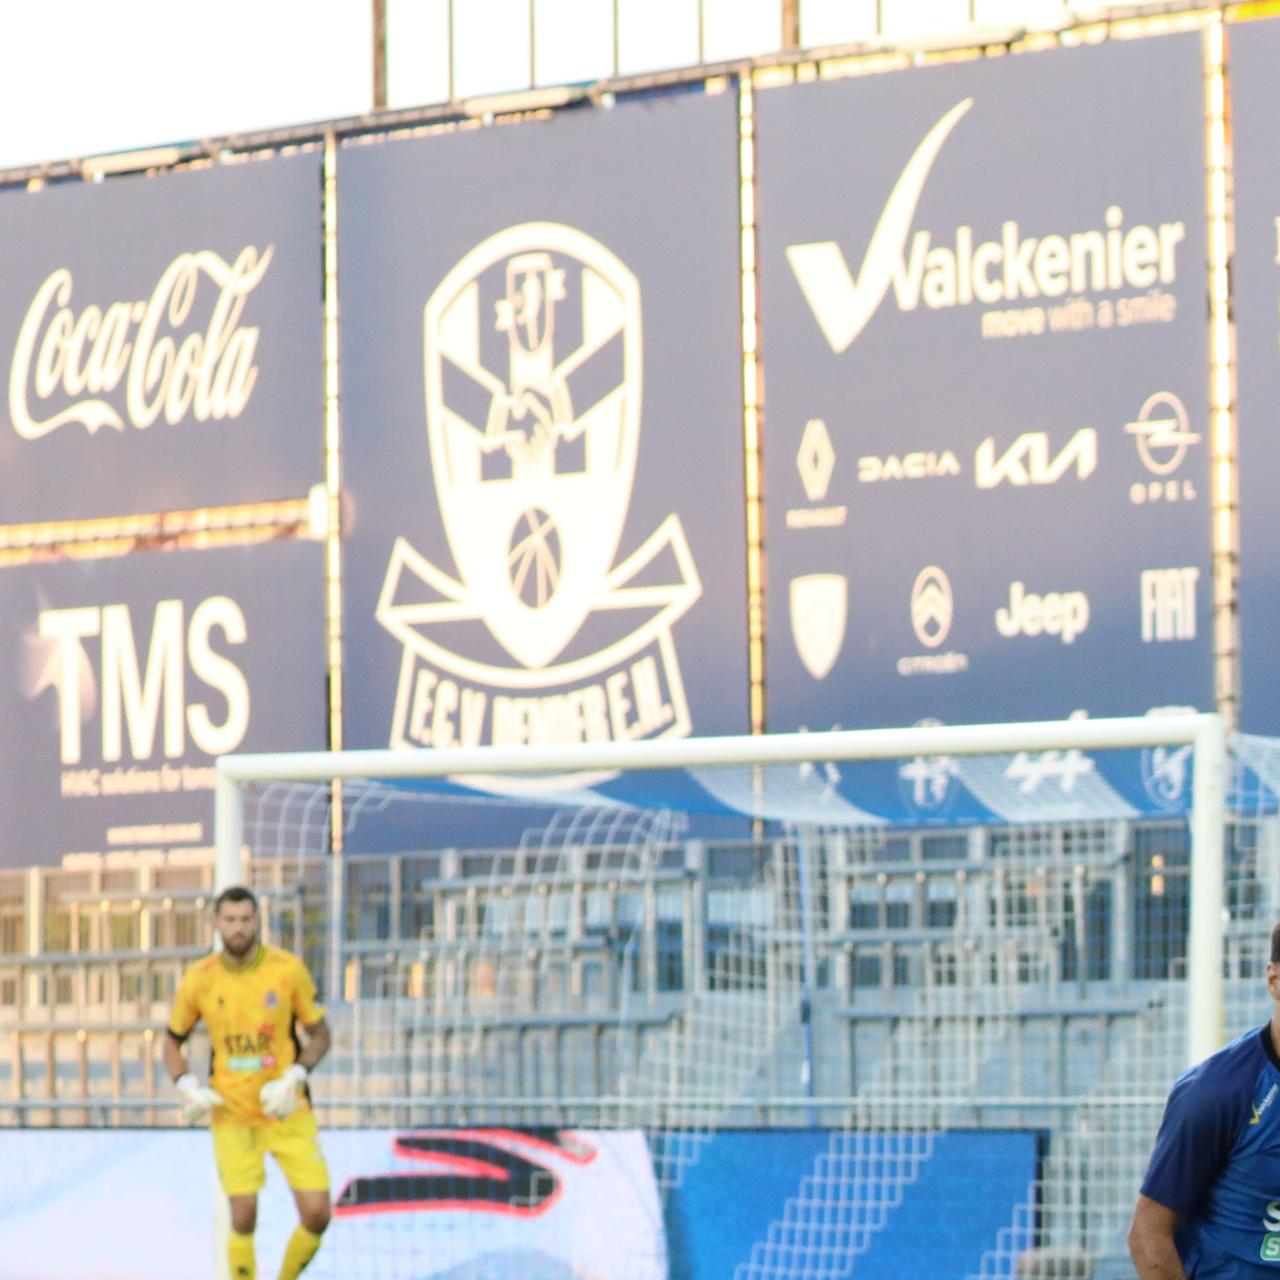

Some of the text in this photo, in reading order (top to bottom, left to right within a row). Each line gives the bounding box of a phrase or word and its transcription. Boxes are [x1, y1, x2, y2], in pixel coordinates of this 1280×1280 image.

[1097, 299, 1114, 328] a
[1116, 289, 1177, 327] smile
[9, 245, 274, 440] Coca-Cola
[857, 450, 960, 482] DACIA
[1129, 480, 1197, 504] OPEL
[996, 567, 1199, 644] Jeep FIAT
[39, 597, 250, 764] TMS
